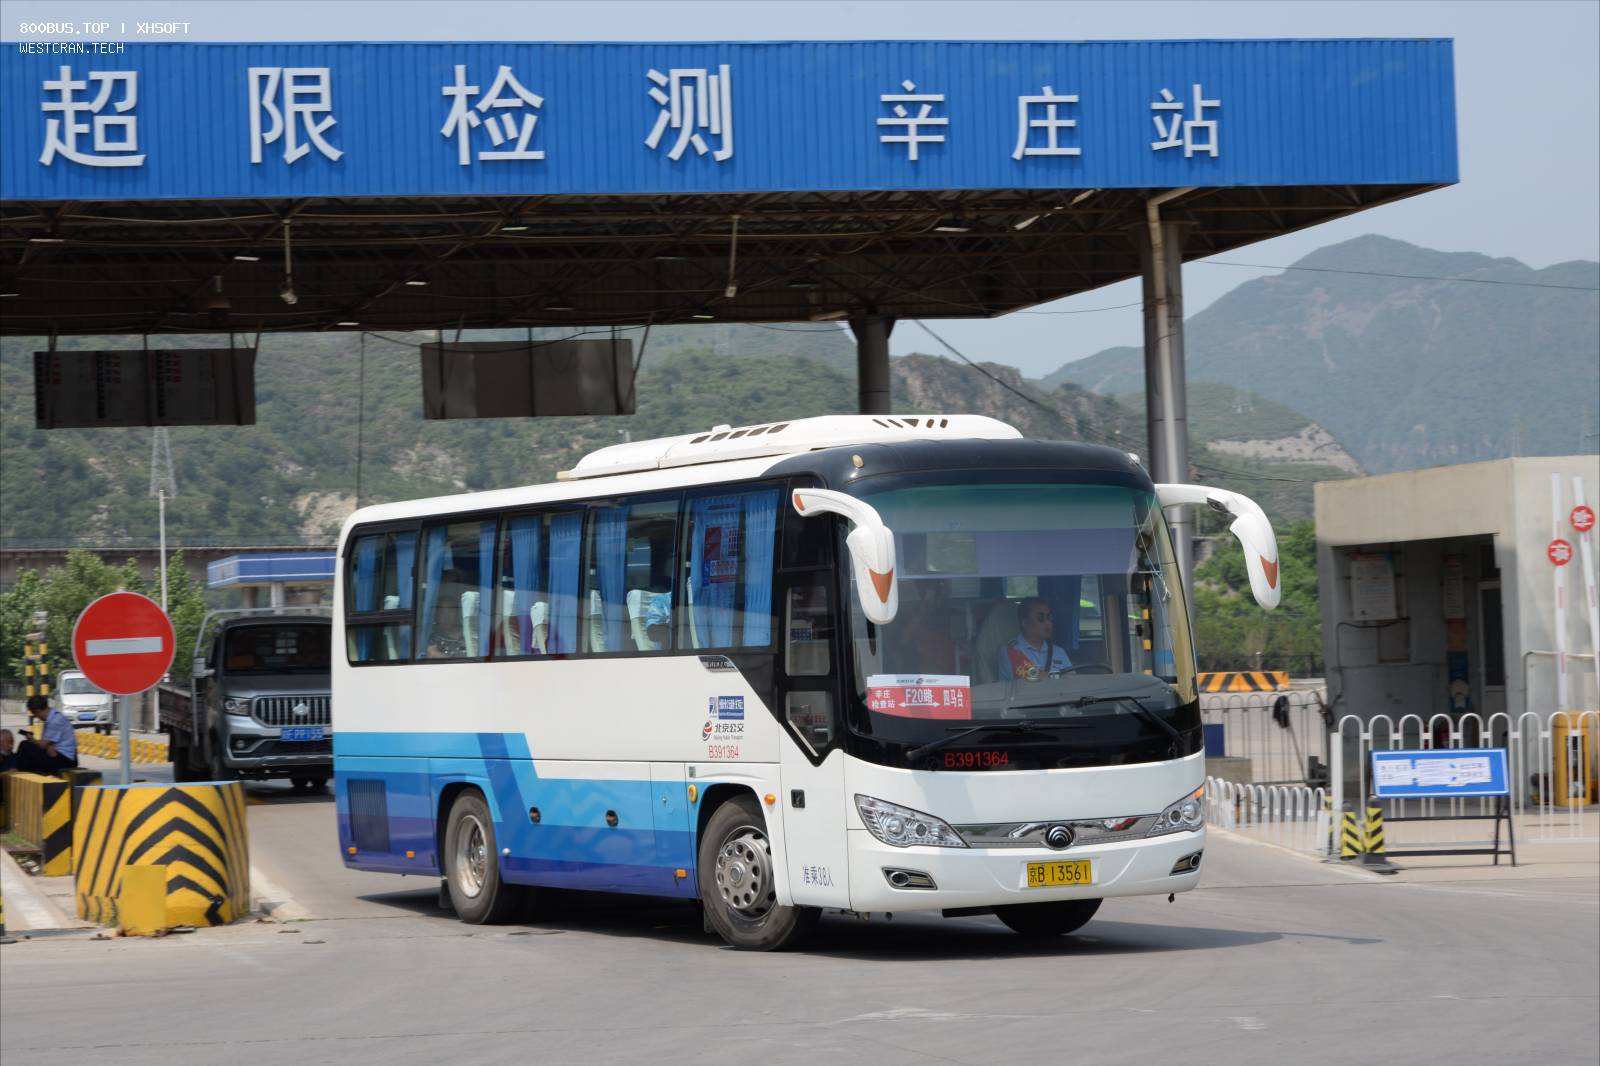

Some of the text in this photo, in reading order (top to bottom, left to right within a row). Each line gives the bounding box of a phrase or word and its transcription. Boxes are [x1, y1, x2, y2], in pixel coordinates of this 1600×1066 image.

[39, 64, 1221, 168] 超限检测 辛庄站
[905, 688, 933, 704] F20路
[715, 723, 744, 733] 北京公交
[709, 745, 739, 759] B391364
[944, 752, 1008, 767] B391364
